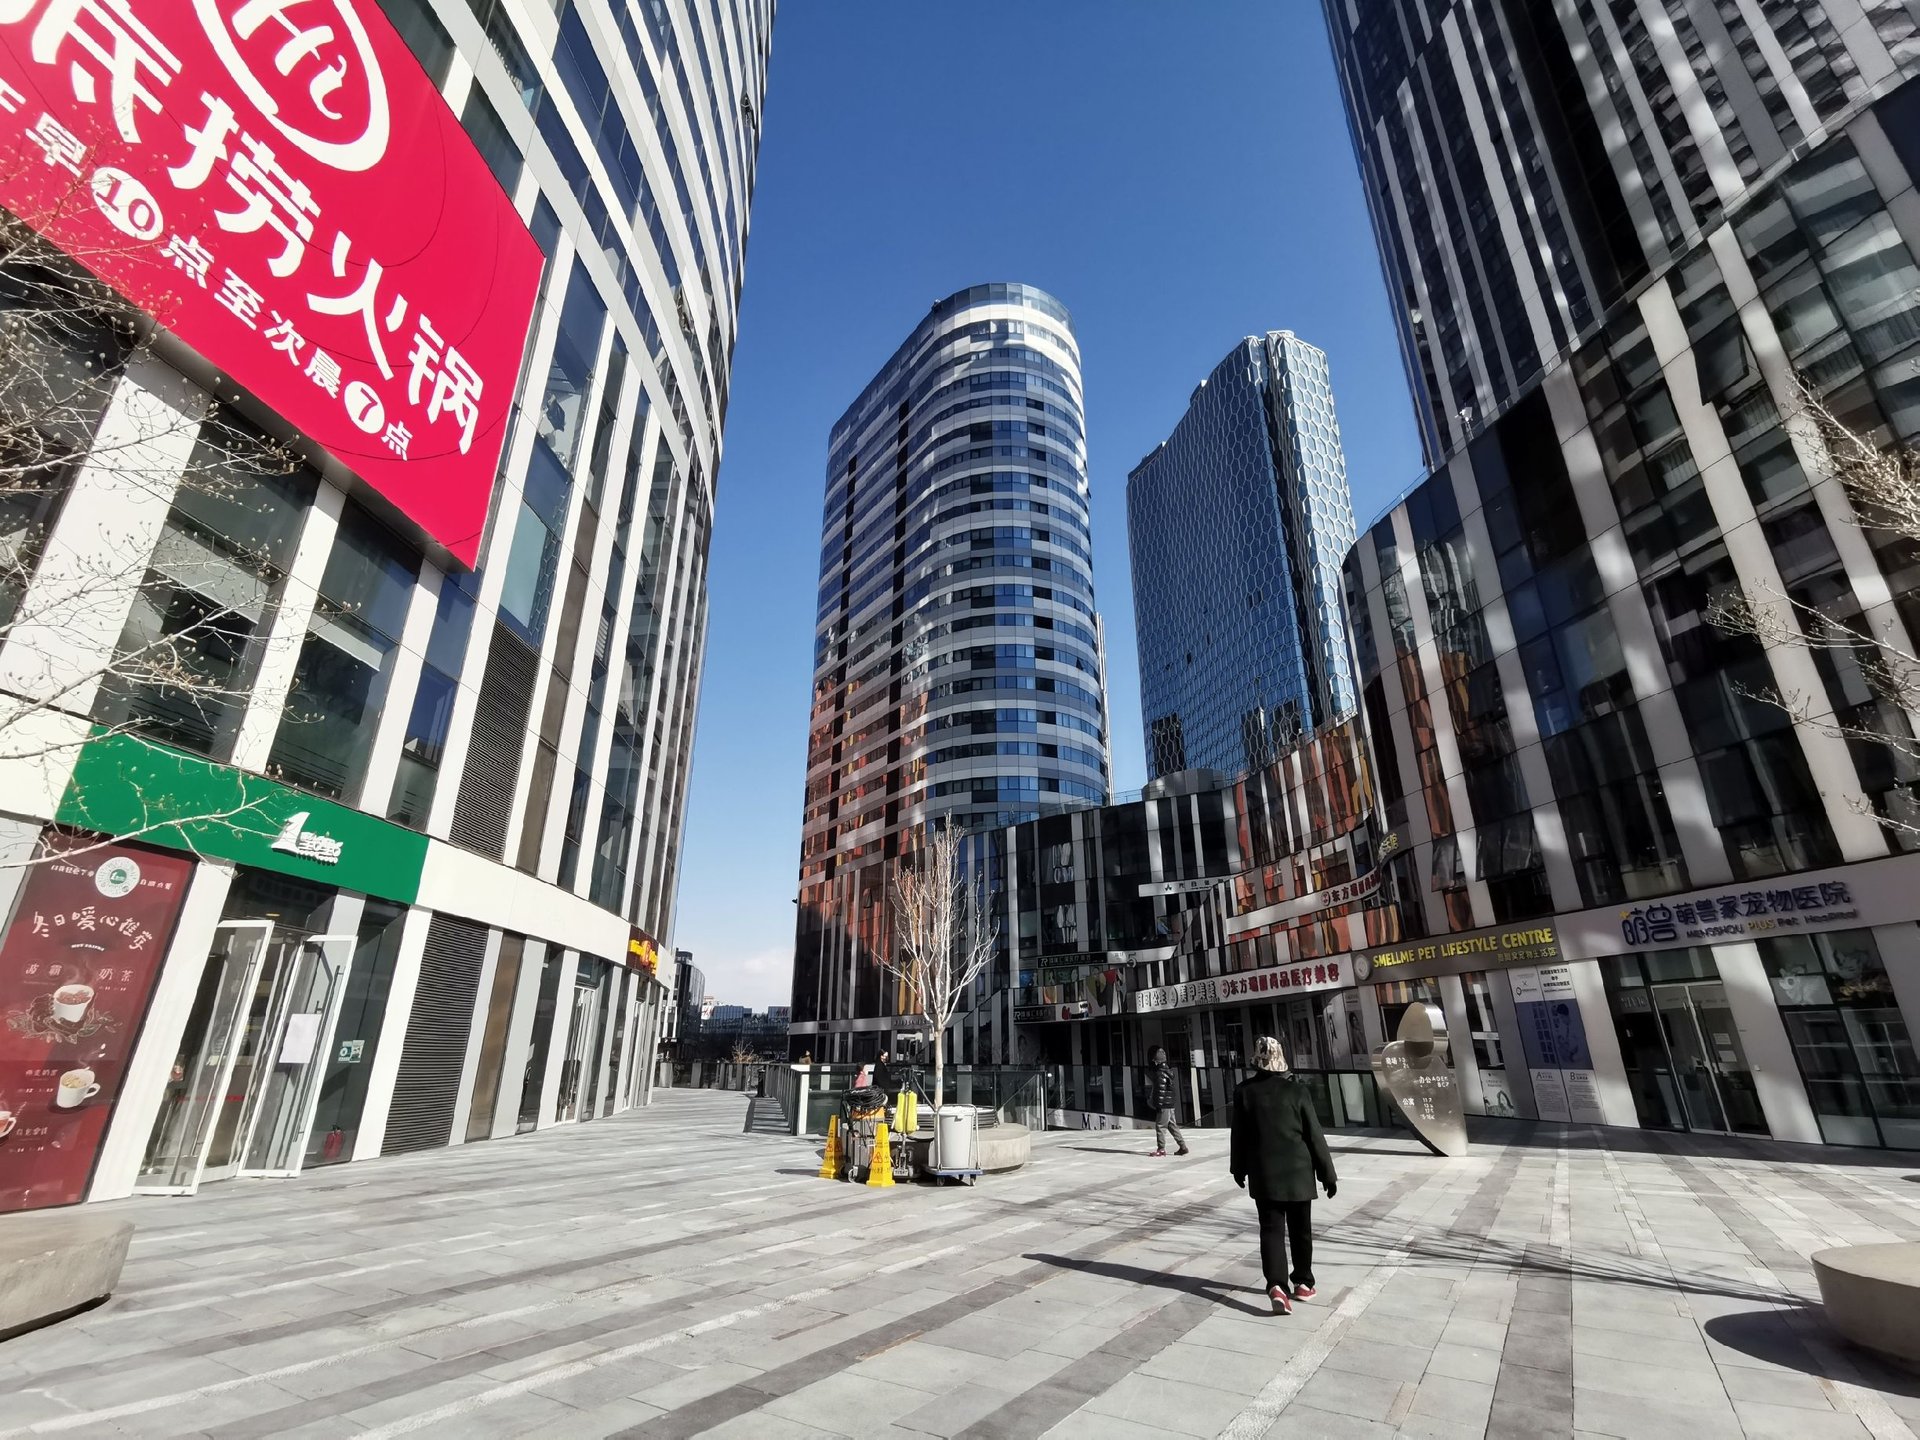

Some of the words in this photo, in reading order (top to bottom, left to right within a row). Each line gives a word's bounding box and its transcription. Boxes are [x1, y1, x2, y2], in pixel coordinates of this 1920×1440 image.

[1672, 880, 1852, 926] 萌兽家宠物医院
[32, 906, 153, 951] 冬日暖心推荐
[1747, 918, 1776, 932] PLUS
[1777, 917, 1800, 928] Pet
[1372, 950, 1415, 968] SMELLME
[1418, 945, 1437, 961] PET
[1440, 935, 1498, 958] LIFESTYLE
[1501, 927, 1554, 949] CENTRE
[97, 967, 133, 983] 奶茶
